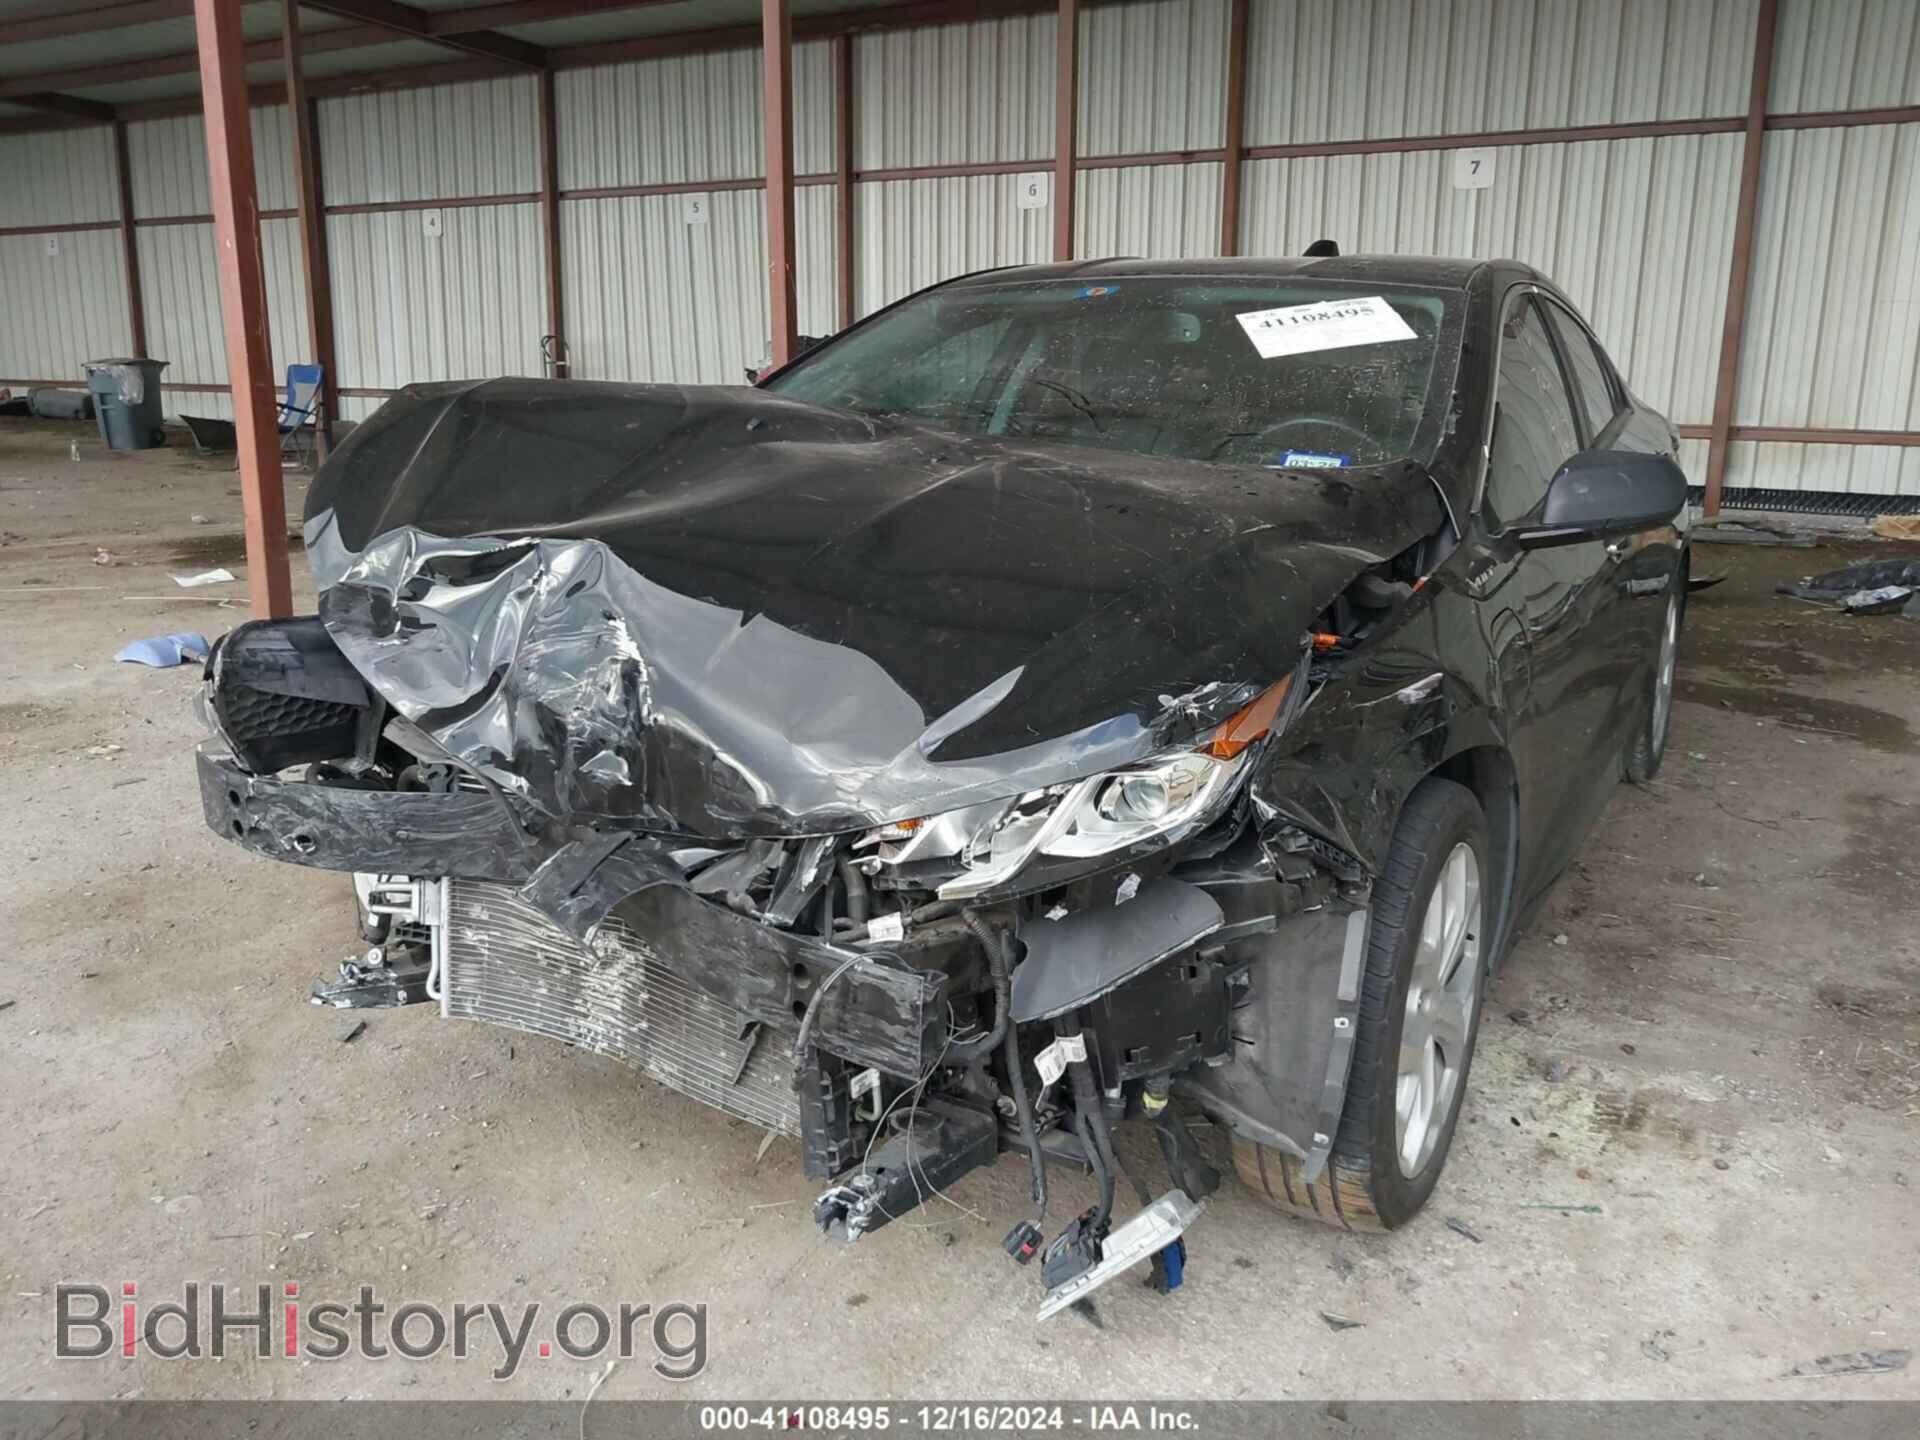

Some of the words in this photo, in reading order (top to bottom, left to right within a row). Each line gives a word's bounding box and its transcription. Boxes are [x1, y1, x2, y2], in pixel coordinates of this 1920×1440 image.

[1470, 160, 1481, 175] 7
[1028, 183, 1037, 197] 6
[692, 201, 700, 214] 5
